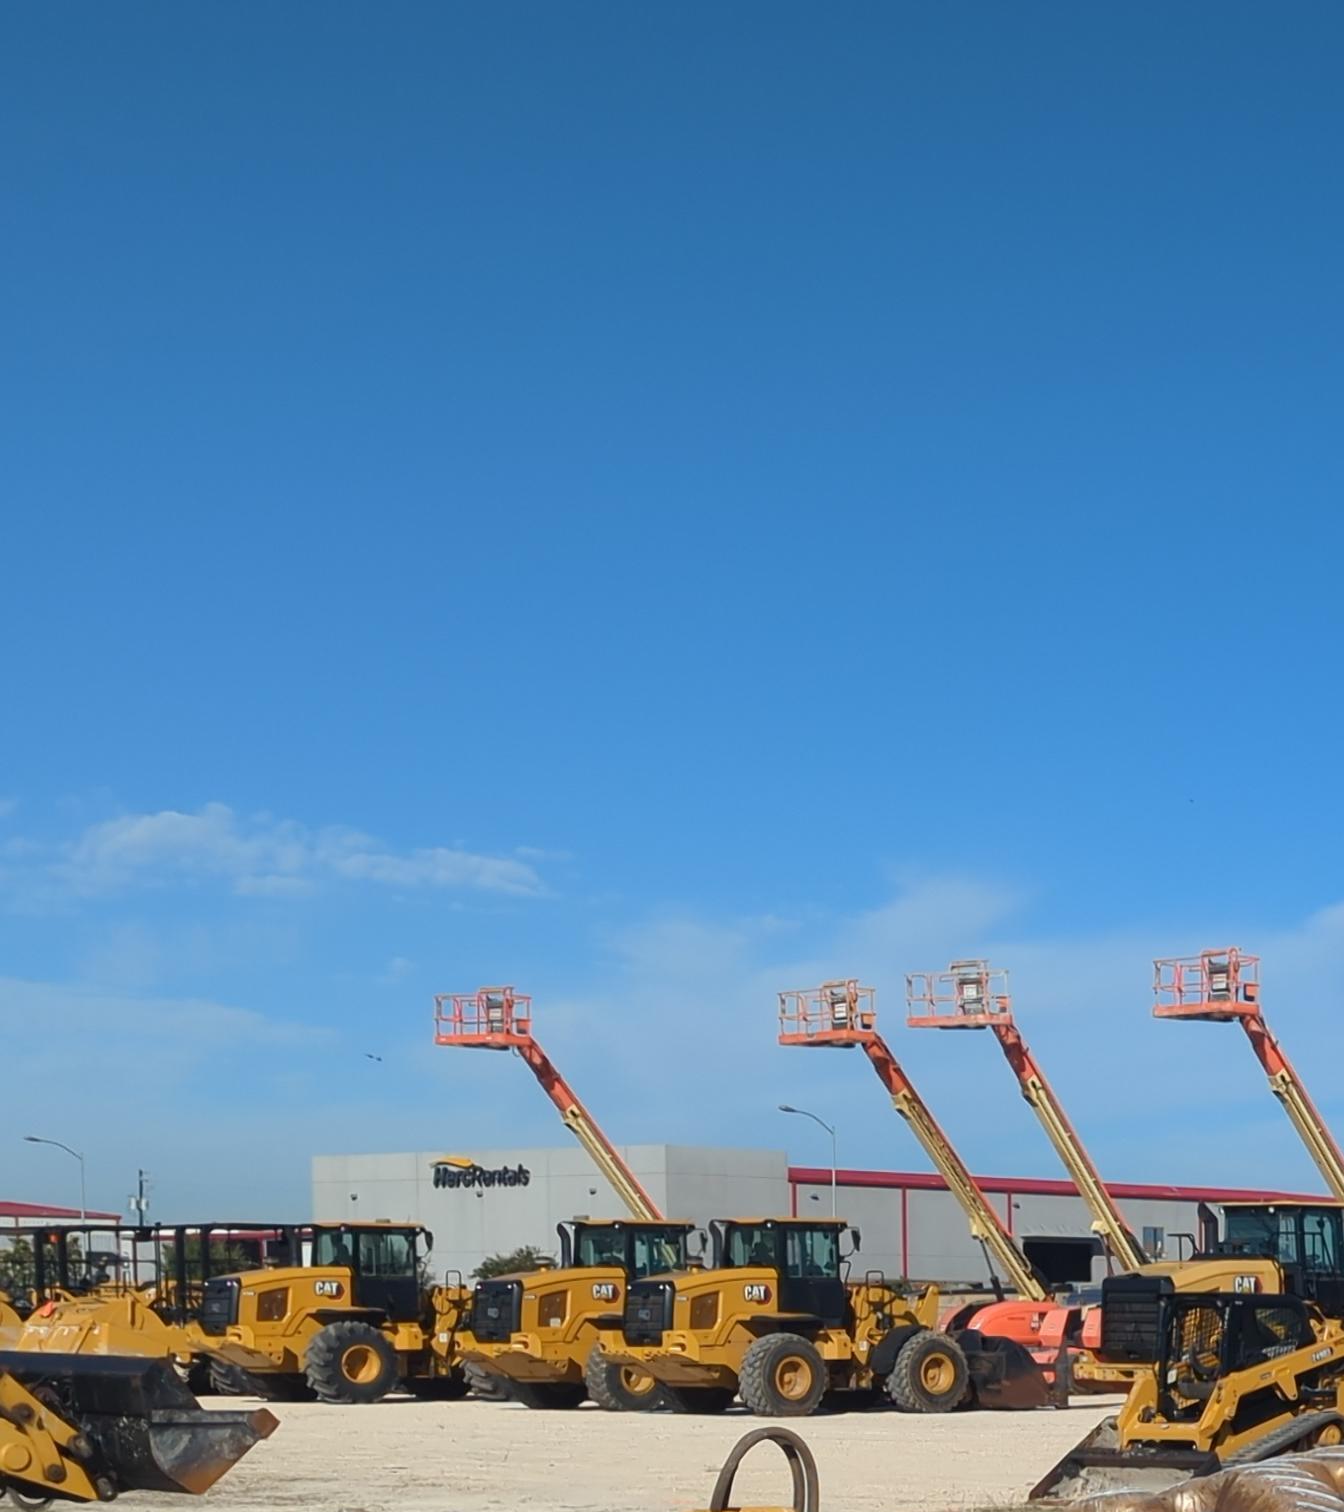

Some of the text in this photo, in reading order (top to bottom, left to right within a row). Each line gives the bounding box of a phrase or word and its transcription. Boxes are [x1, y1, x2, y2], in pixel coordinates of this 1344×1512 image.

[314, 1281, 338, 1296] CAT
[592, 1283, 614, 1300] CAT
[744, 1285, 766, 1301] CAT
[1235, 1276, 1256, 1294] CAT
